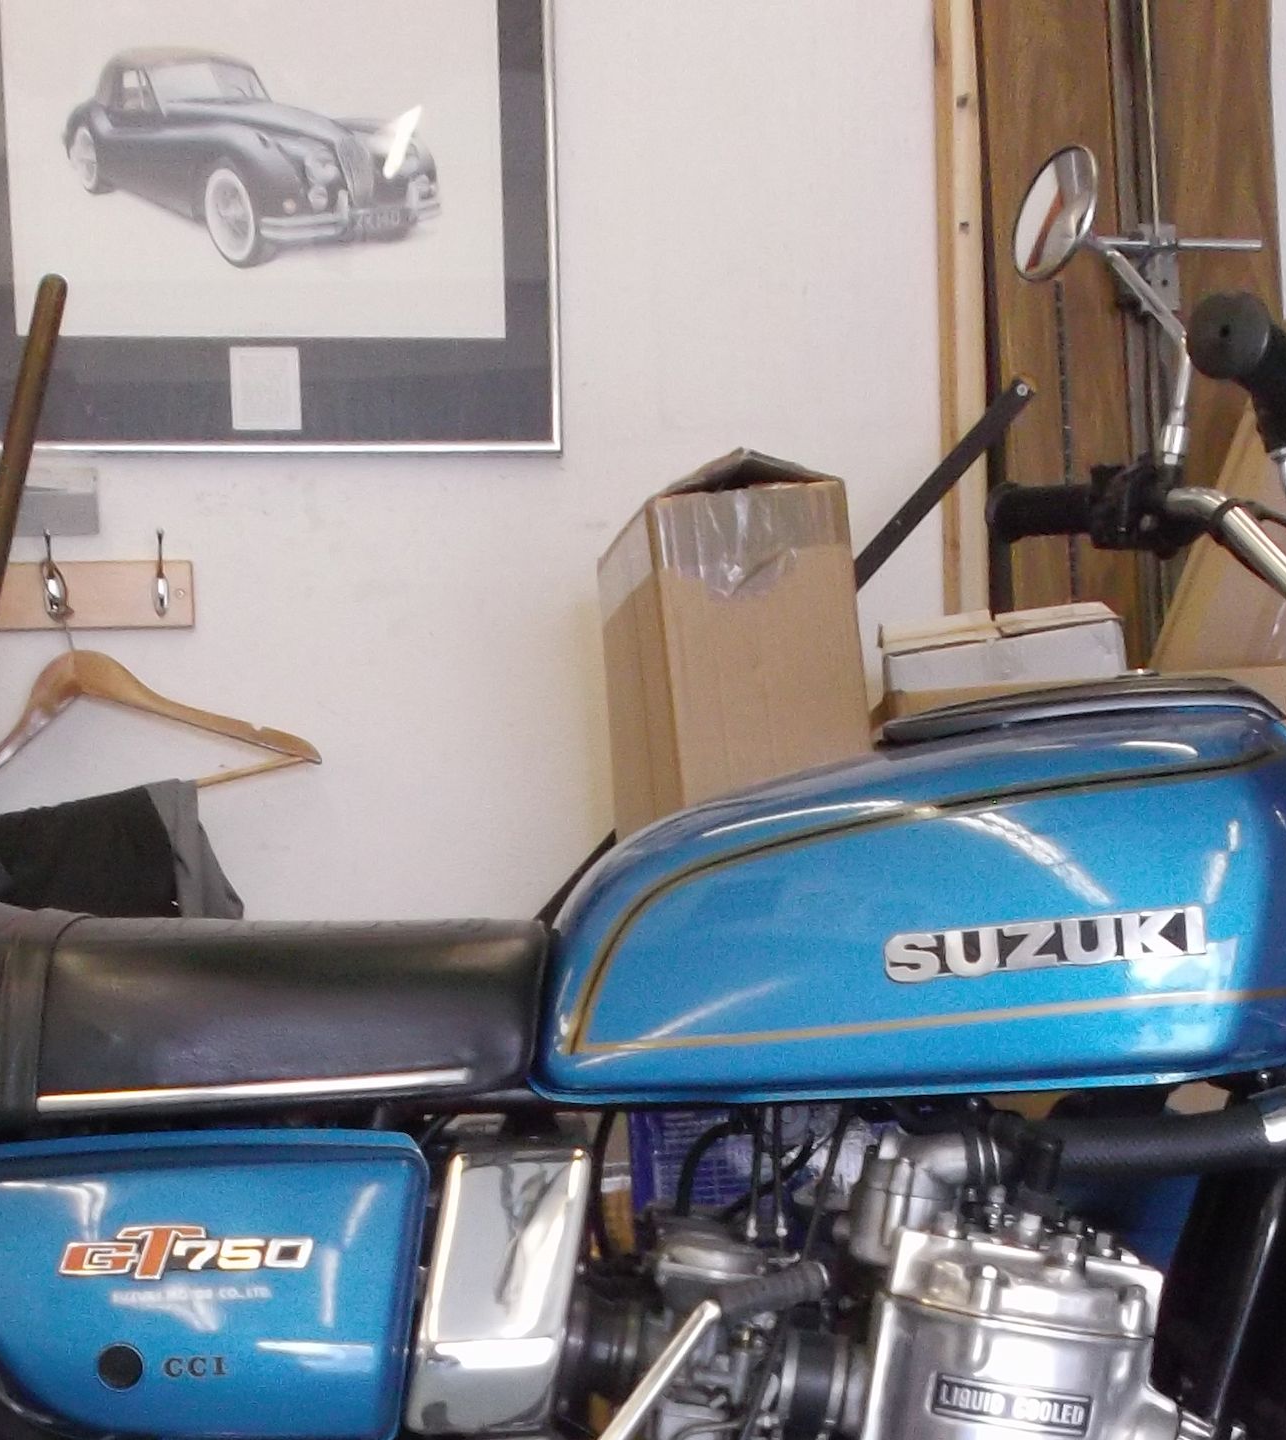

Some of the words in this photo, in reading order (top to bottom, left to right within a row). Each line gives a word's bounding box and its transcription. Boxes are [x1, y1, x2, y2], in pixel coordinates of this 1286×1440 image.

[884, 905, 1207, 983] SUZUKI
[59, 1224, 314, 1281] GT750
[164, 1357, 227, 1377] CCI
[940, 1383, 1006, 1416] LIQUID
[1011, 1396, 1086, 1425] COOLED
